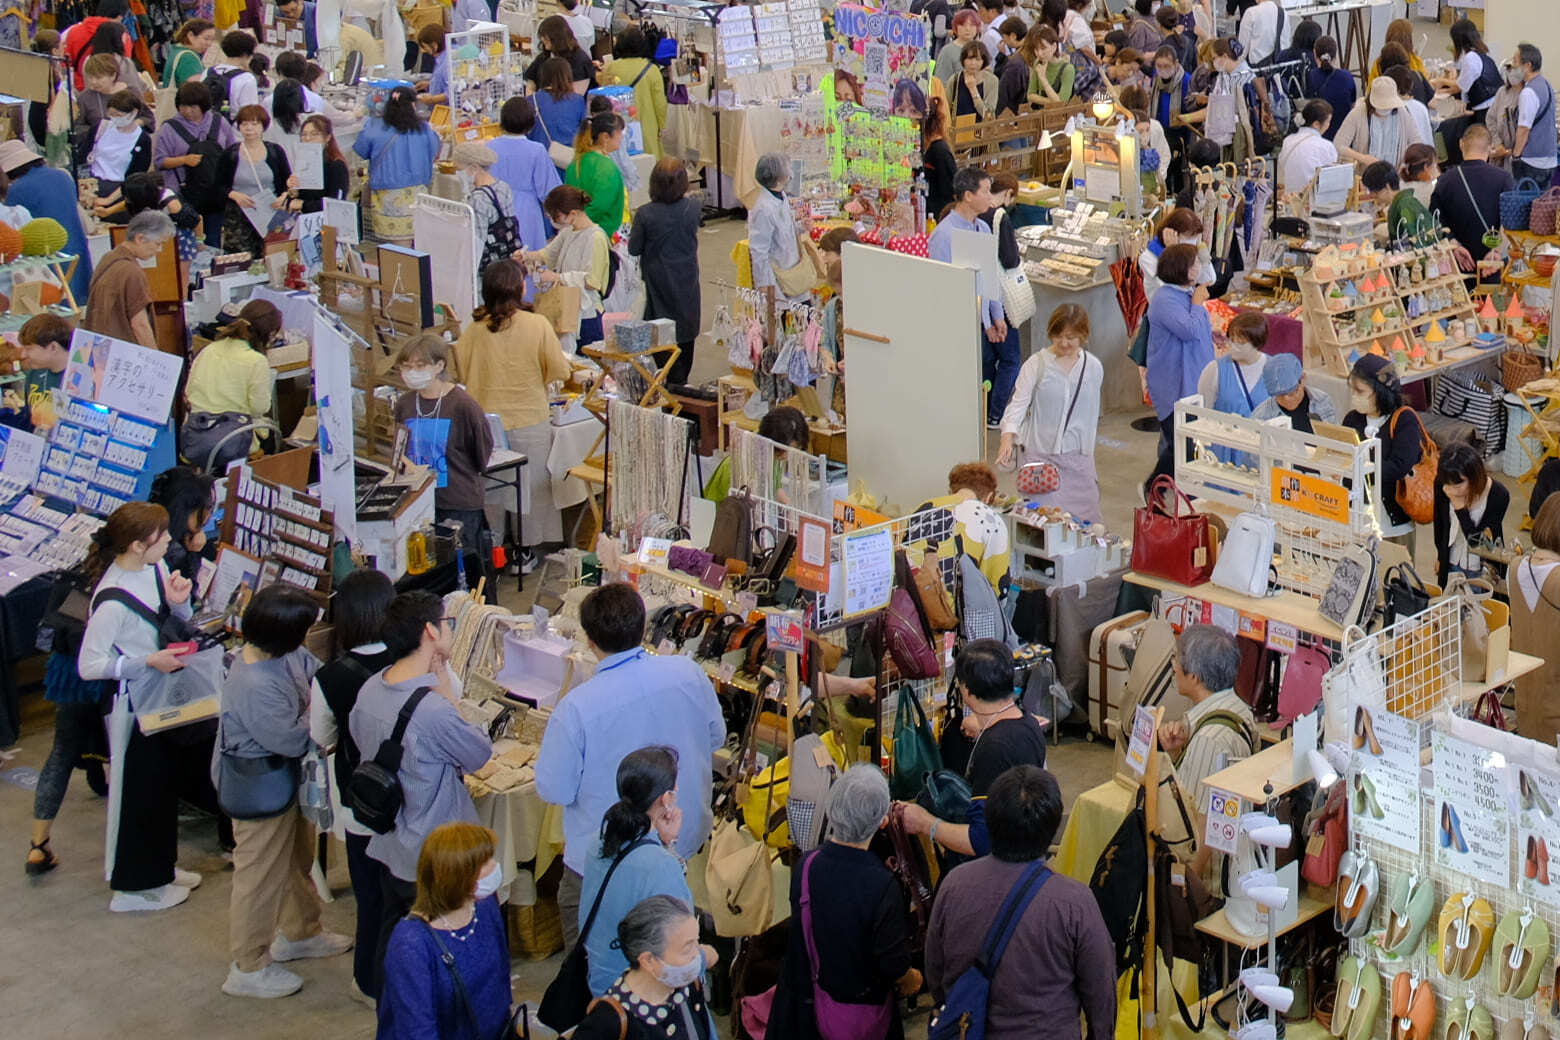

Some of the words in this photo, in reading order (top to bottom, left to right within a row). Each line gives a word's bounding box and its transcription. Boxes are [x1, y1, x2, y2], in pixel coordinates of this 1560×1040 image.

[107, 374, 165, 399] アクセサリー
